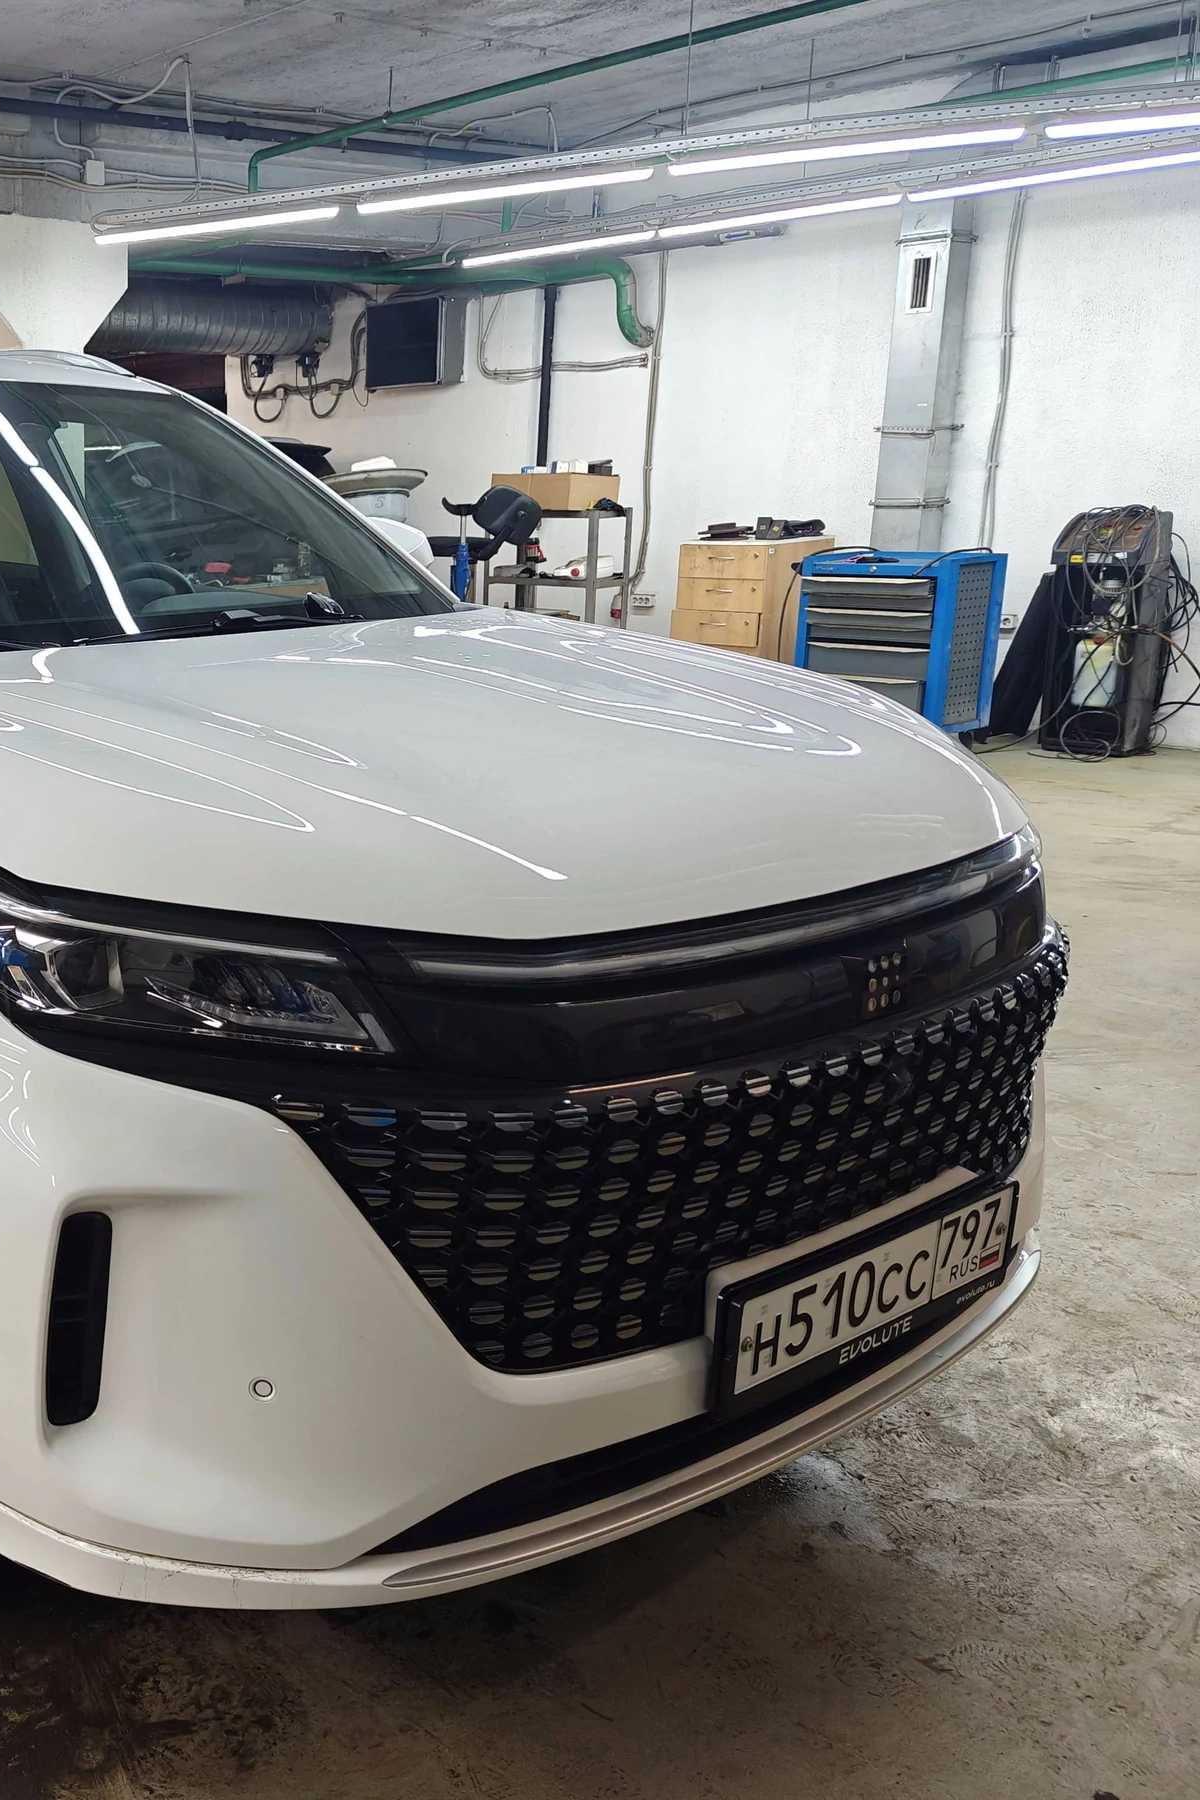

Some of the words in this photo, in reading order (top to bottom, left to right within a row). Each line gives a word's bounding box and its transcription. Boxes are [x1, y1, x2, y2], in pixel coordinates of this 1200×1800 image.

[375, 496, 386, 509] 5
[941, 1197, 1001, 1269] 797
[949, 1255, 978, 1283] RUS
[956, 1280, 996, 1305] evolute.ru
[839, 1315, 913, 1365] EVOLUTE
